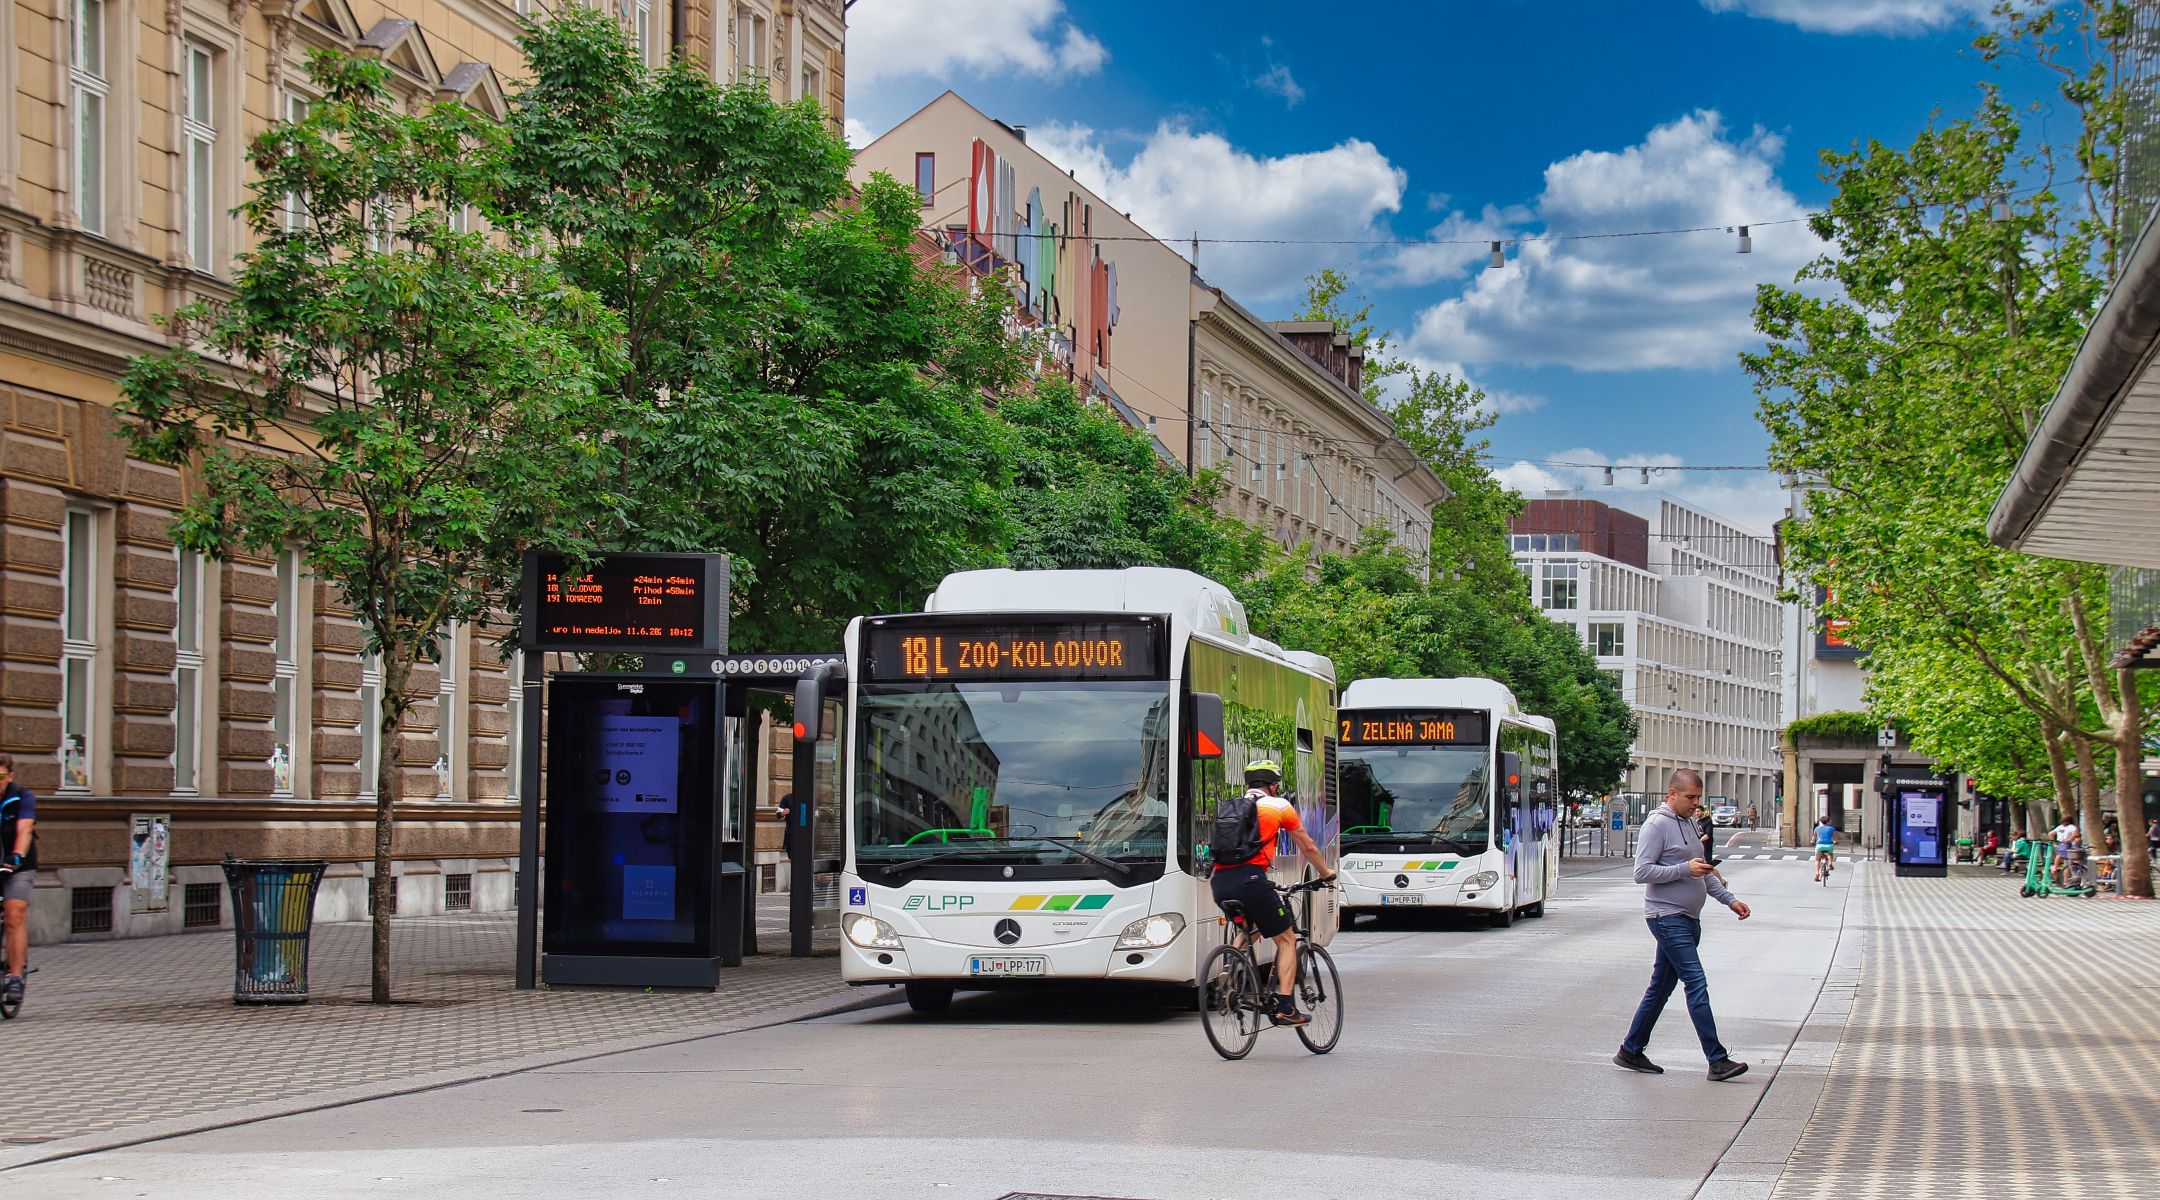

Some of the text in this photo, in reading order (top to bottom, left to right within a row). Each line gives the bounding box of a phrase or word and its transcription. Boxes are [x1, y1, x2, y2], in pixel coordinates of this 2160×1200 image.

[633, 586, 663, 595] Prihod
[638, 596, 662, 605] 12min
[553, 626, 568, 634] uro
[572, 625, 582, 634] in
[958, 639, 1122, 668] ZOO-KOLODVOR
[714, 659, 721, 671] 1
[730, 660, 735, 671] 2
[744, 660, 750, 671] 3
[758, 660, 764, 671] 6
[772, 660, 778, 671] 9
[785, 660, 794, 671] 11
[1341, 720, 1455, 742] 2 ZELENA JAMA
[1357, 860, 1384, 870] LPP
[927, 895, 975, 911] LPP
[981, 960, 995, 972] LJ
[1003, 960, 1042, 972] LPP-177
